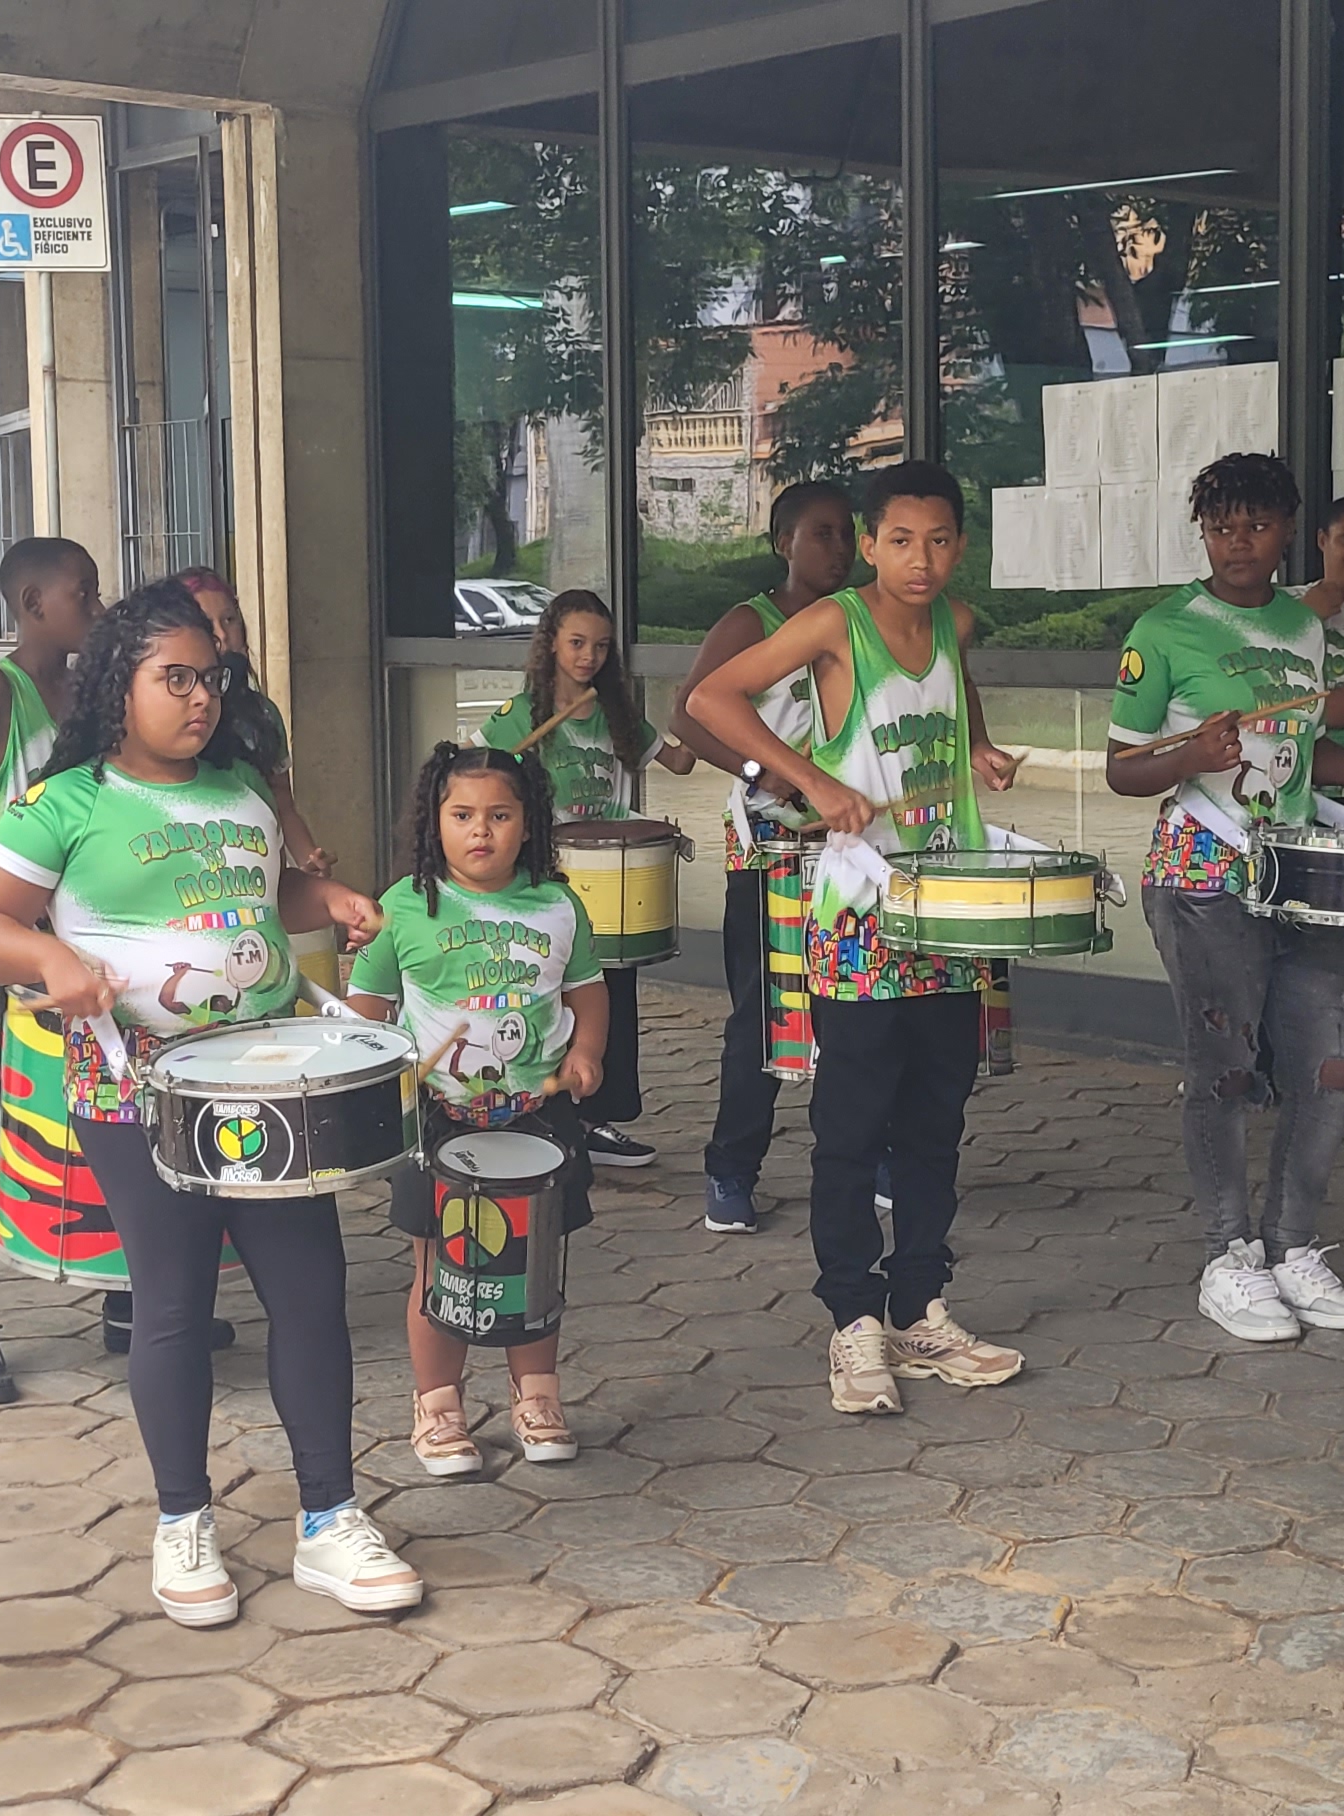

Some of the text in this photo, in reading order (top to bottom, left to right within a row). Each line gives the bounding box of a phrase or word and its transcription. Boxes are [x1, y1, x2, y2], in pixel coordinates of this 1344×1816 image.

[26, 140, 58, 190] E
[32, 216, 92, 229] EXCLUSIVO
[33, 230, 93, 242] DEFICIENTE
[34, 241, 69, 254] FÍSICO
[128, 819, 269, 865] TAMBORES
[174, 865, 267, 909] MORRO
[186, 907, 266, 932] MIRIM
[436, 919, 552, 959] TAMBORES
[468, 992, 532, 1011] MIRIM
[439, 1268, 504, 1301] TAMBORES
[459, 1295, 470, 1306] DO
